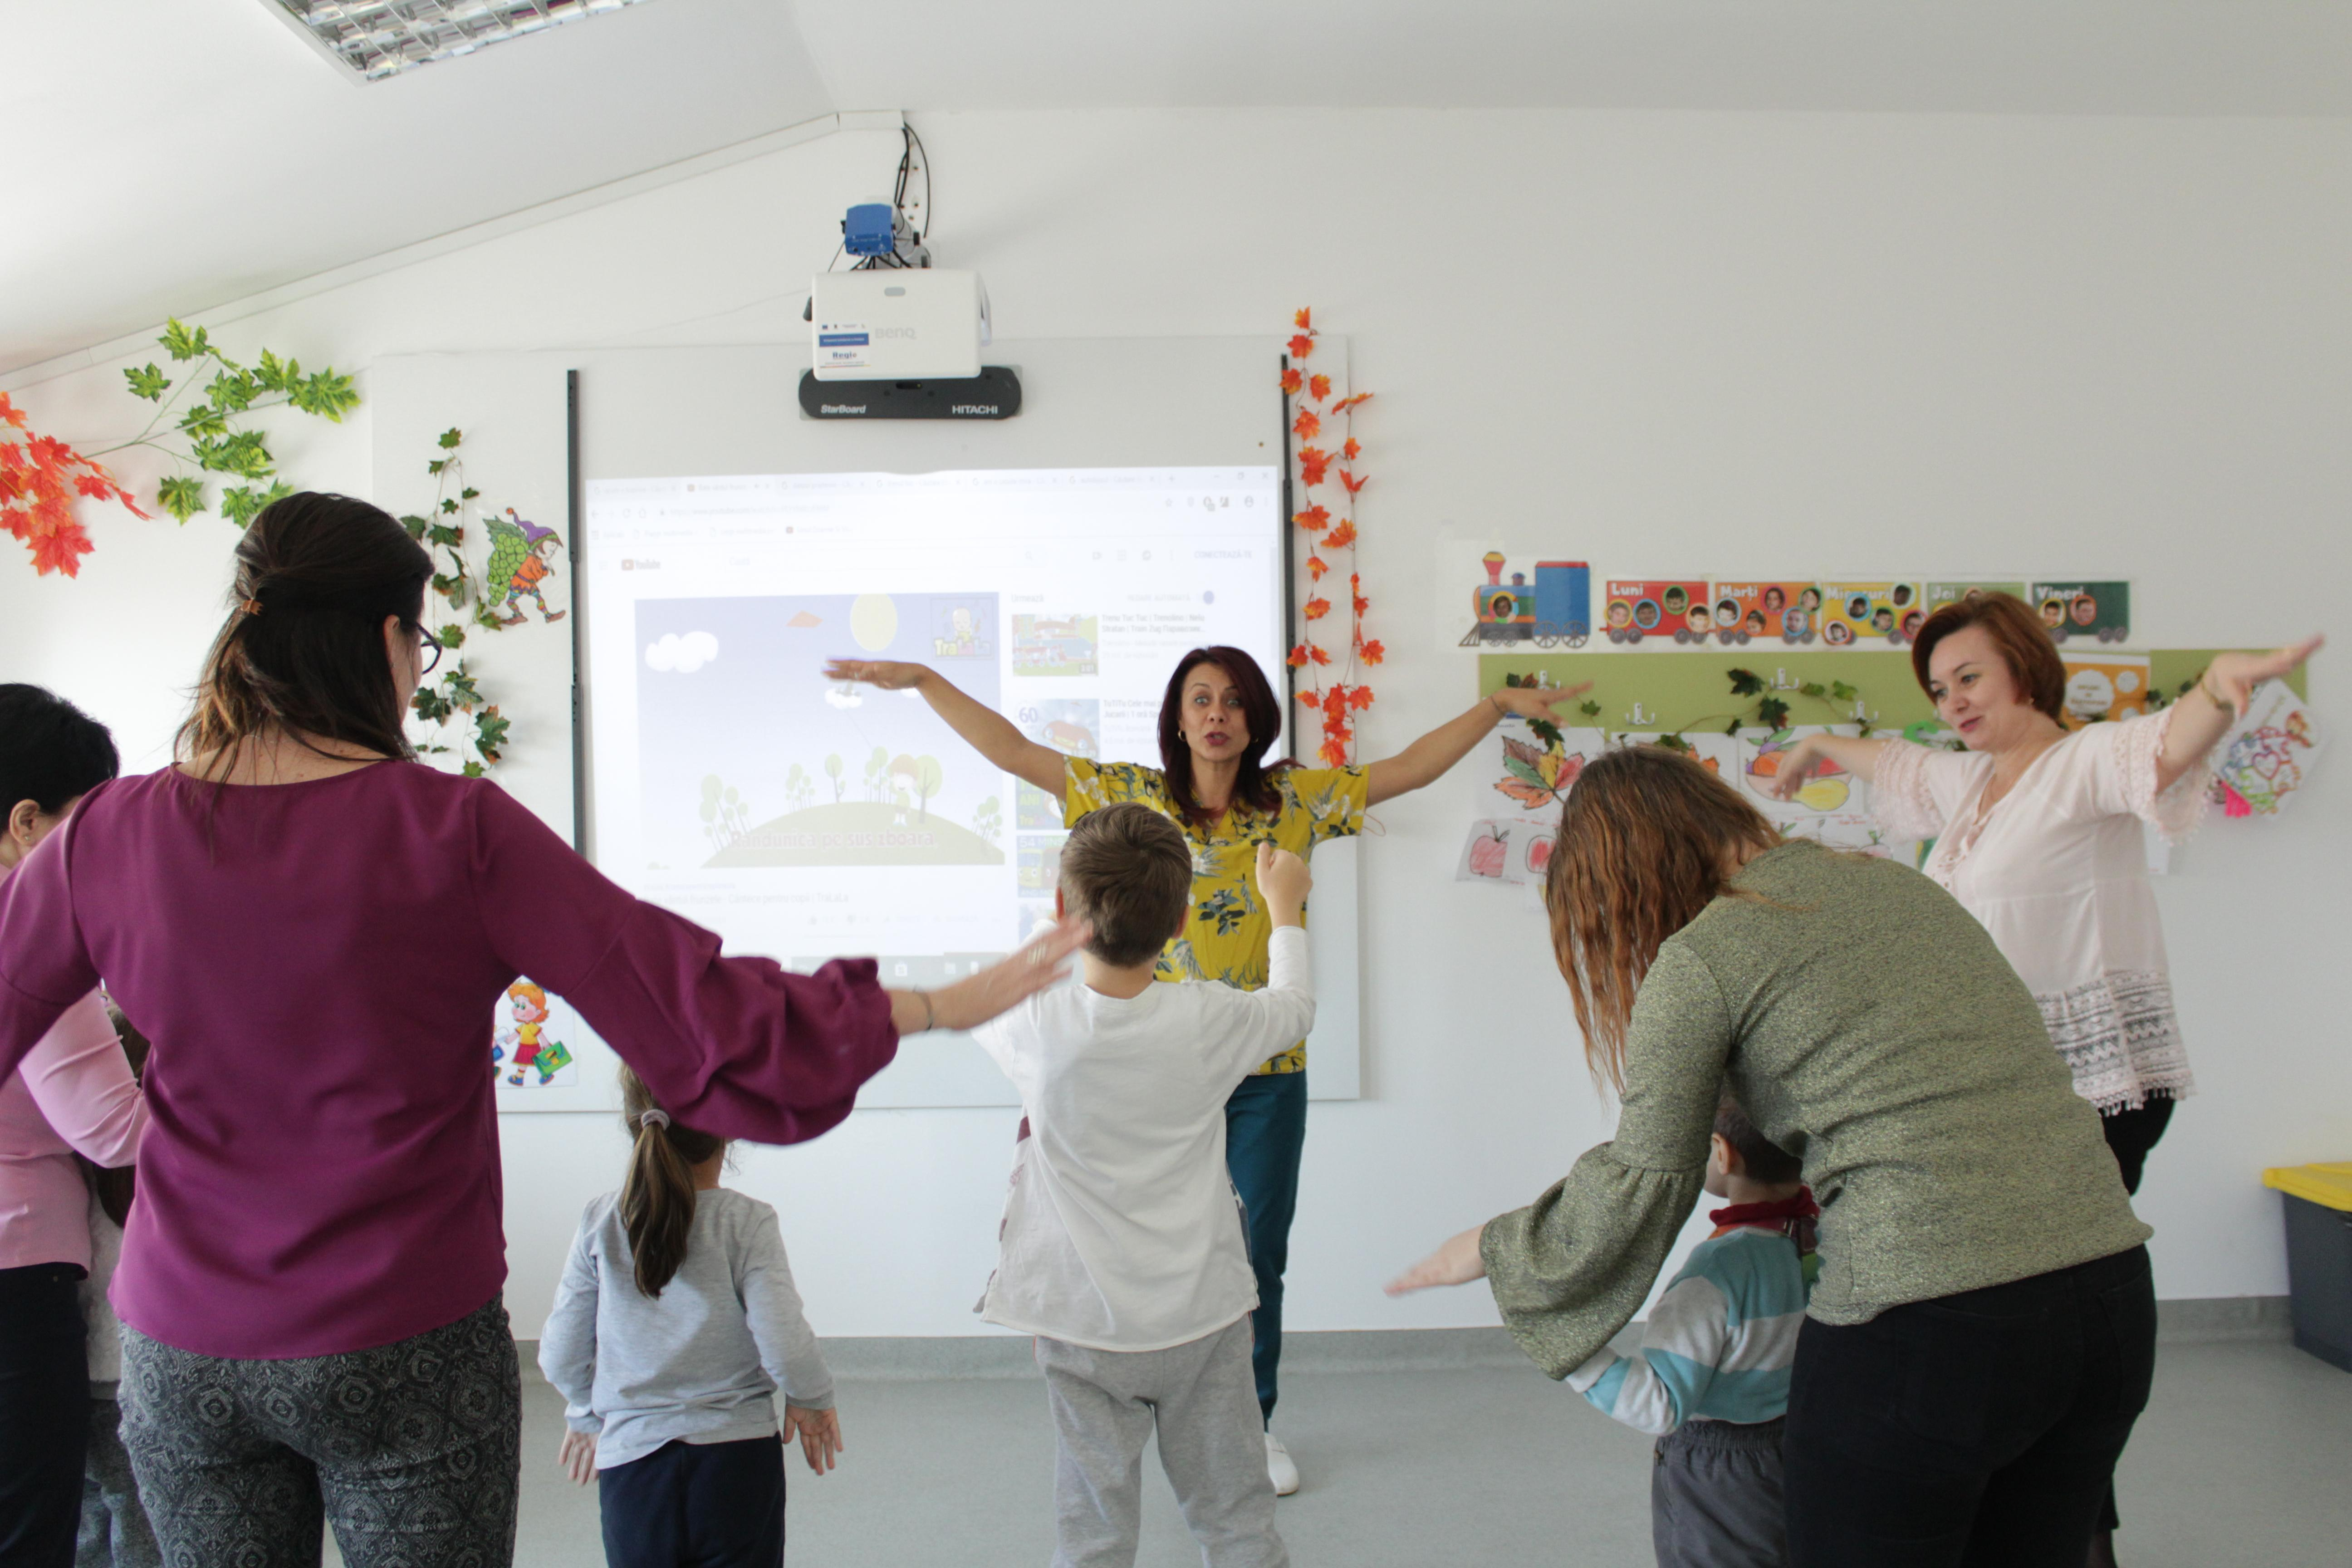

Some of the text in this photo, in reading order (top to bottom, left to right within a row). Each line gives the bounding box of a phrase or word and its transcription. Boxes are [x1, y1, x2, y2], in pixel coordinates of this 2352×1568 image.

[821, 404, 866, 414] StarBoard
[952, 405, 998, 414] HITACHI
[1612, 583, 1644, 596] Luni
[1931, 585, 1956, 600] Joi
[1019, 707, 1038, 723] 60
[822, 833, 842, 851] pe
[847, 832, 873, 847] sus
